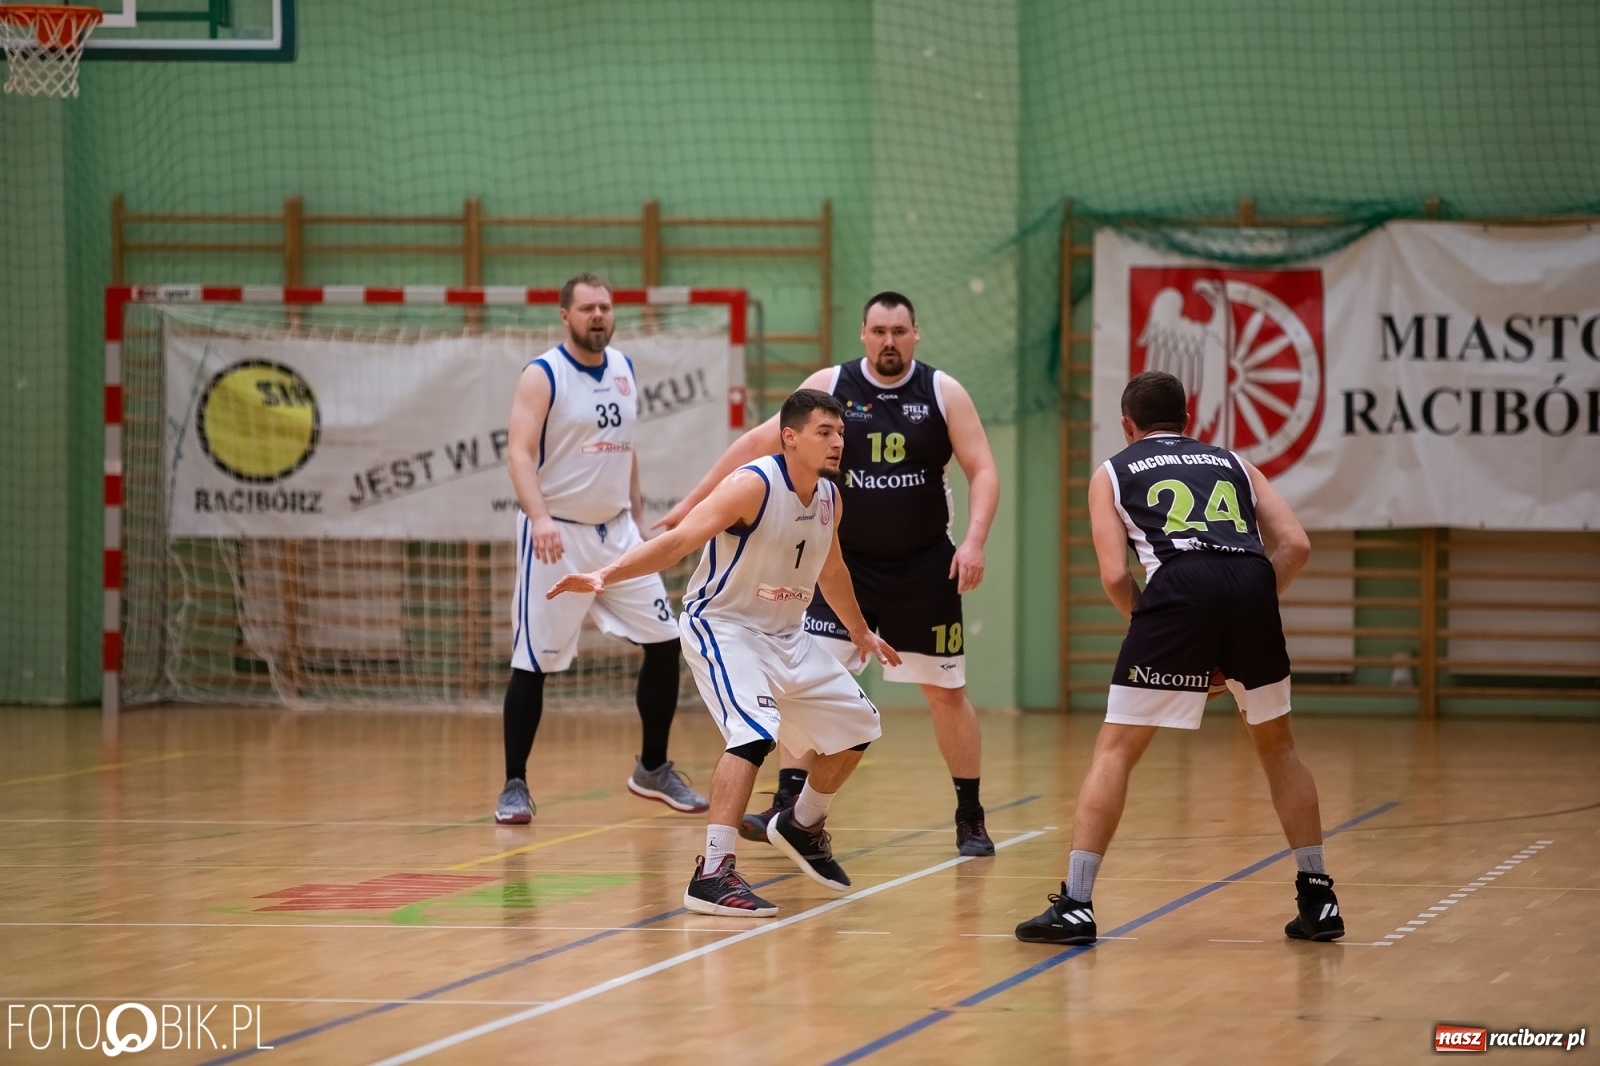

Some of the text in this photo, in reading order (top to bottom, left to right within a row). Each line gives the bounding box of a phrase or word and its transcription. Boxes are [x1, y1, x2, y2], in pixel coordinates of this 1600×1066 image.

[595, 402, 622, 429] 33
[844, 410, 873, 419] Cieszyn
[902, 404, 929, 416] STELA
[866, 432, 906, 464] 18
[348, 450, 435, 505] JEST
[443, 436, 480, 472] W
[1127, 454, 1233, 475] NACOMI CIESZYN
[847, 469, 926, 489] Nacomi
[194, 486, 323, 514] RACIBÓRZ
[1147, 479, 1249, 537] 24
[794, 539, 807, 570] 1
[654, 597, 676, 622] 3
[930, 622, 963, 654] 18
[1132, 665, 1210, 688] Nacomi
